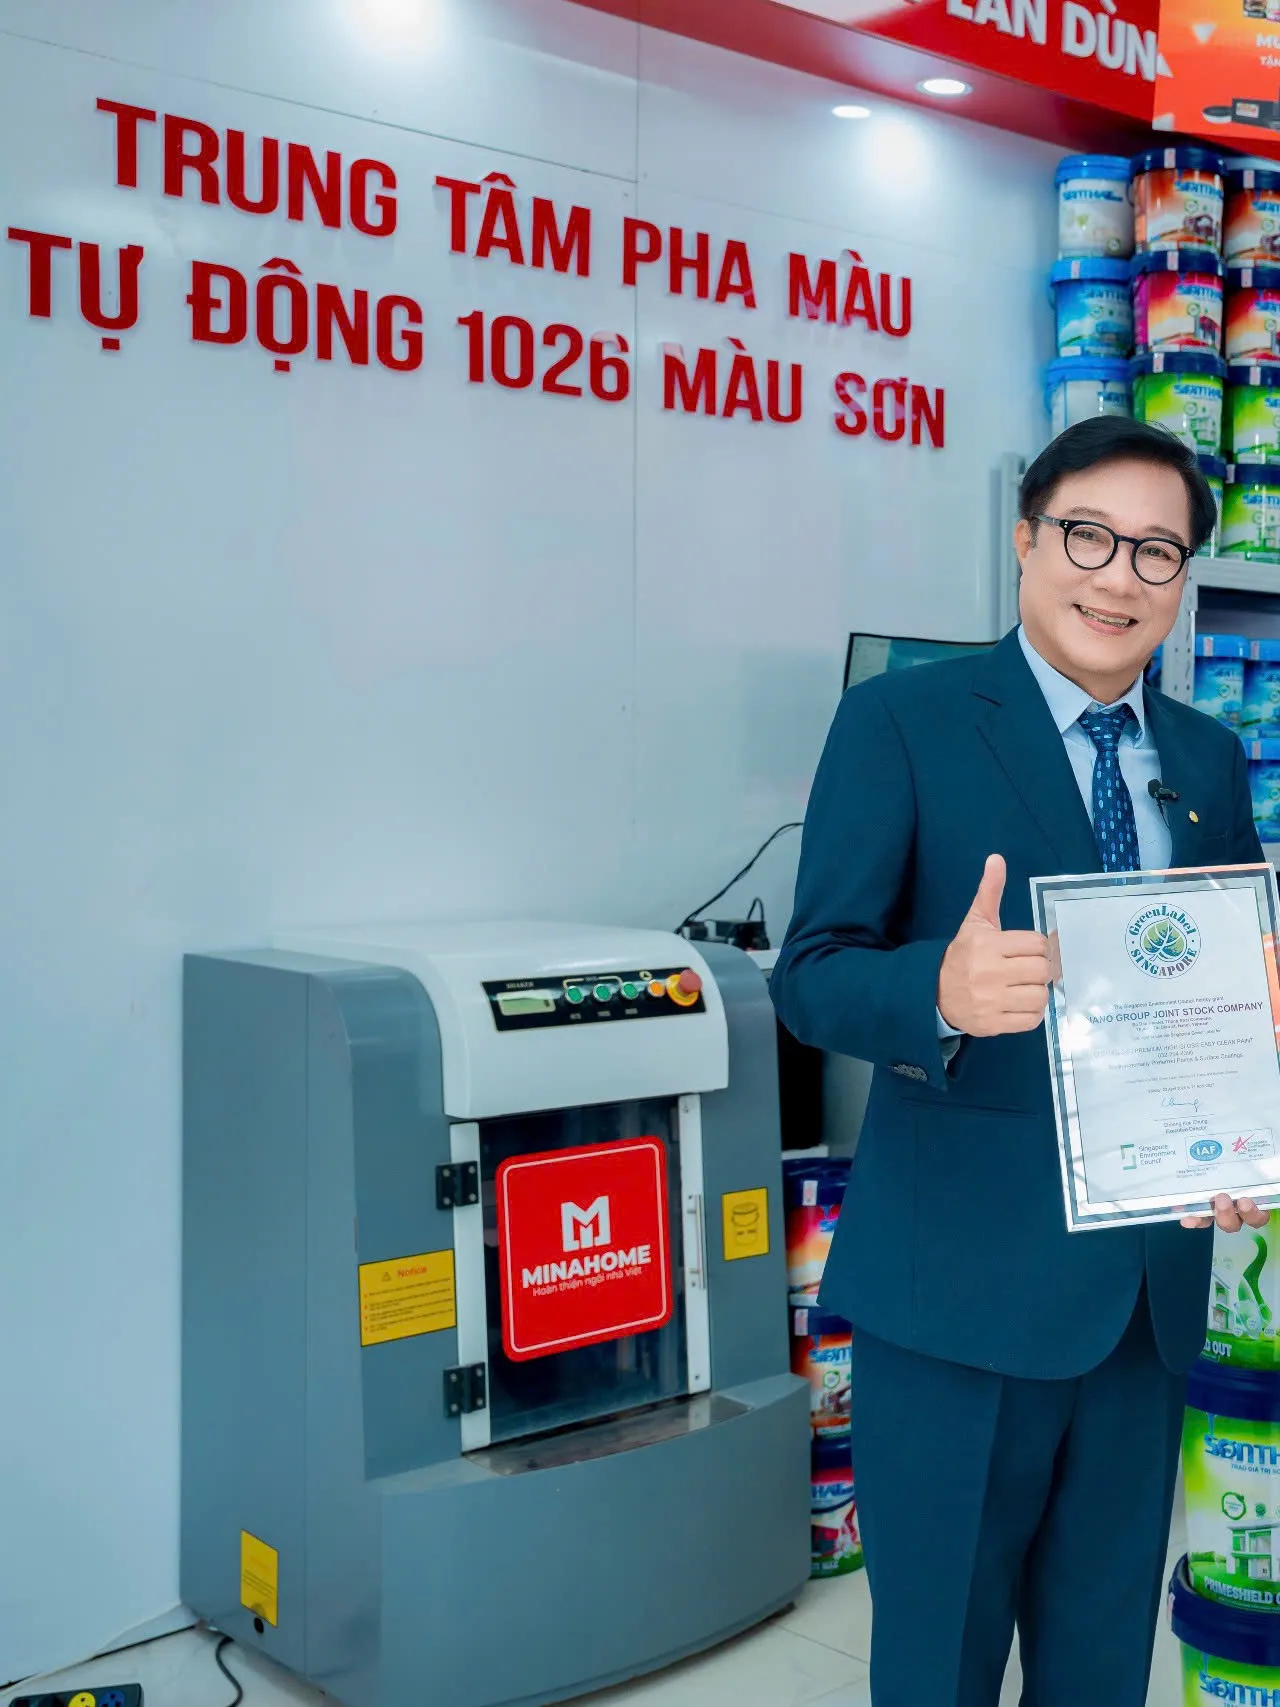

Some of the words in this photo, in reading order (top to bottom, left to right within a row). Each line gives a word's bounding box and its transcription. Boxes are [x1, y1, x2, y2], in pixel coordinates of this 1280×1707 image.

[1062, 0, 1157, 82] DÙN
[95, 97, 398, 239] TRUNG
[434, 170, 591, 278] TÂM
[622, 216, 757, 310] PHA
[787, 248, 912, 338] MÀU
[6, 227, 146, 351] TỰ
[186, 256, 425, 373] ĐỘNG
[457, 309, 630, 402] 1026
[662, 336, 803, 425] MÀU
[834, 372, 946, 449] SƠN
[1130, 948, 1198, 977] SINGAPORE
[1115, 1011, 1150, 1022] GROUP
[1152, 1008, 1180, 1019] JOINT
[1182, 1006, 1215, 1016] STOCK
[1217, 1001, 1264, 1013] COMPANY
[1138, 1143, 1169, 1153] Singapore
[1139, 1149, 1177, 1159] Environment
[1196, 1145, 1216, 1157] IAF
[1140, 1157, 1162, 1165] Council
[522, 1244, 651, 1288] MINAHOME
[1211, 1341, 1232, 1358] OUT
[1204, 1576, 1274, 1605] PRIMESHIELD
